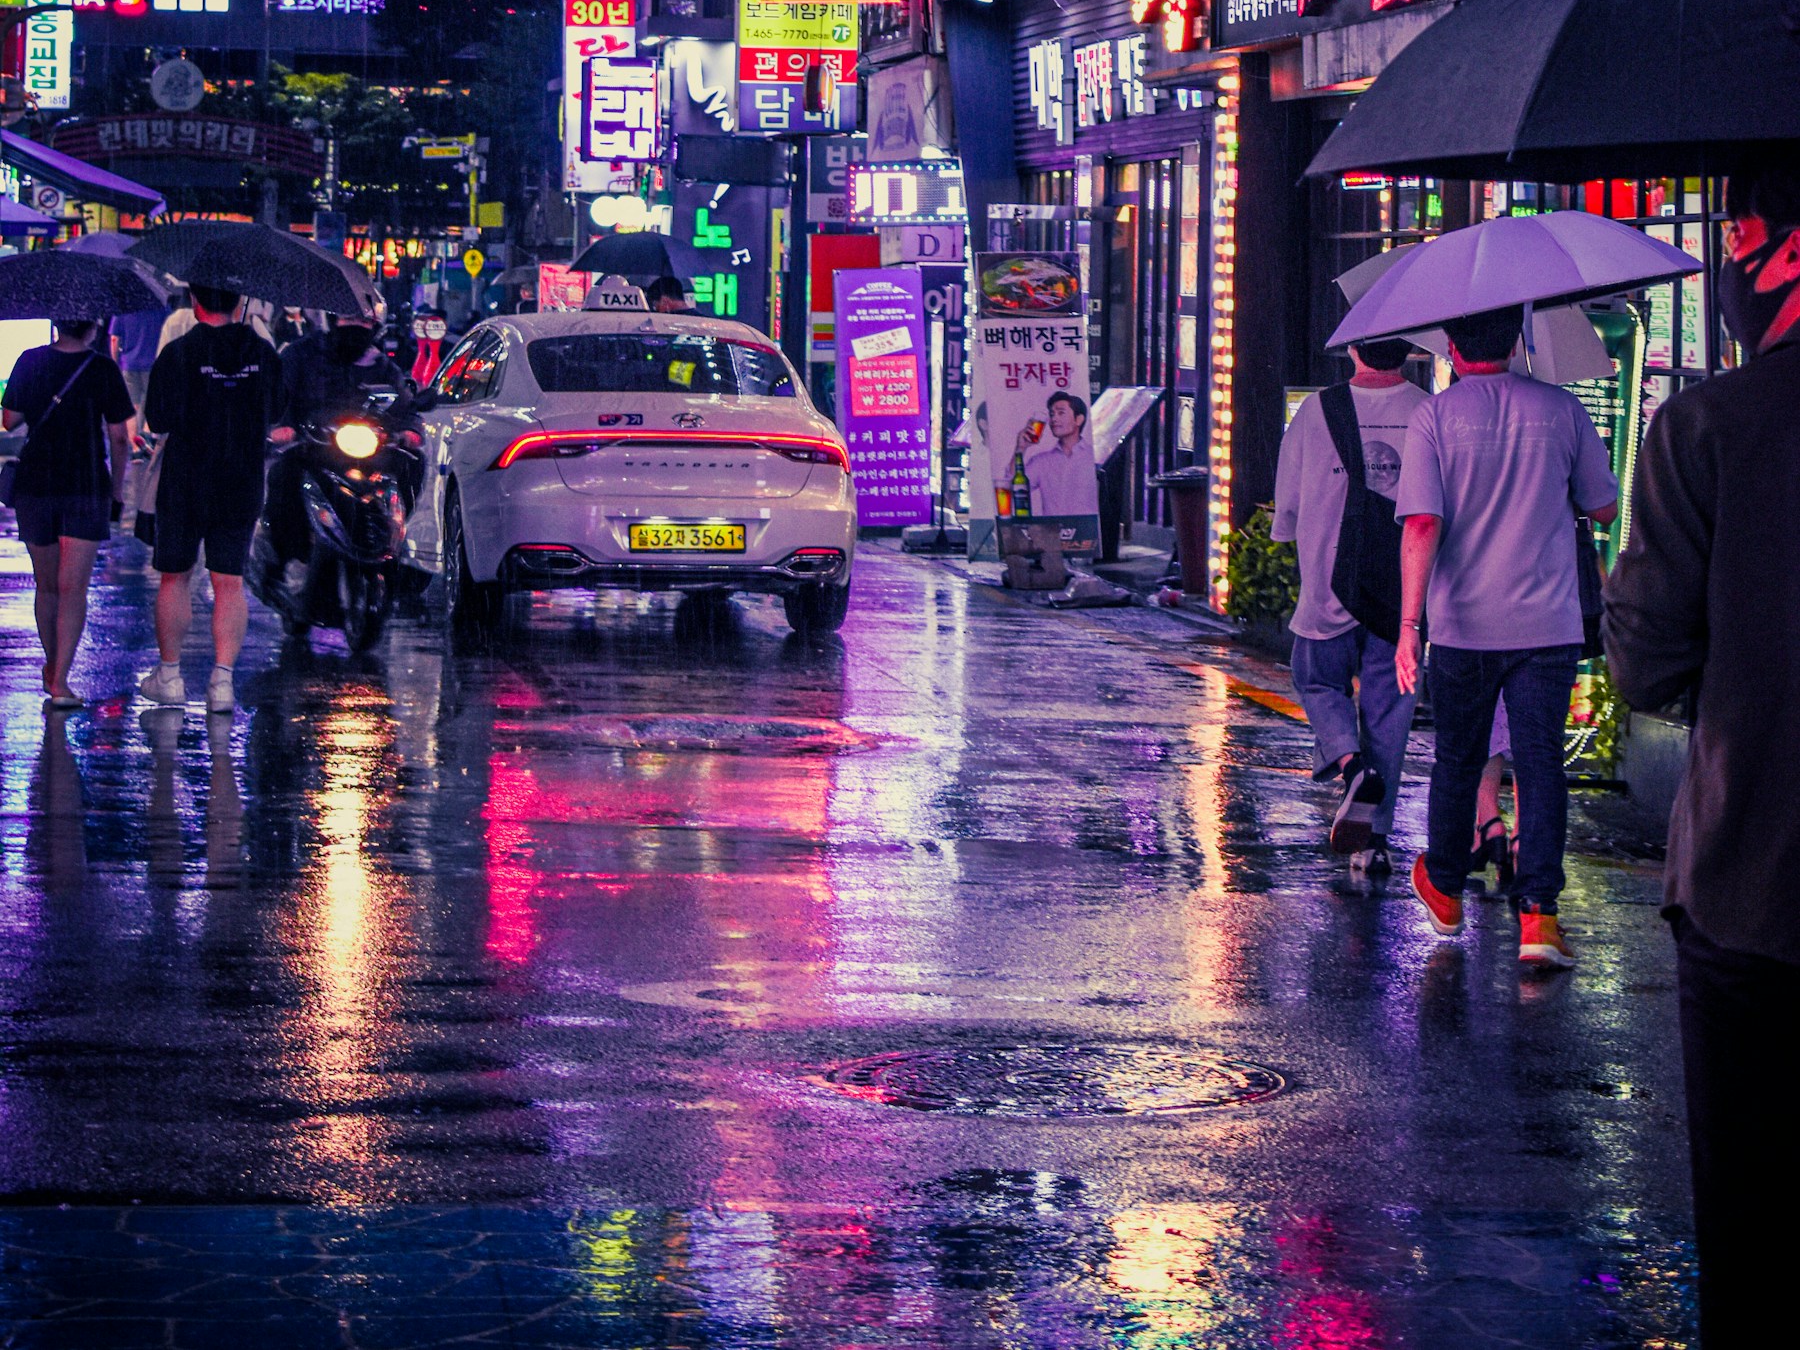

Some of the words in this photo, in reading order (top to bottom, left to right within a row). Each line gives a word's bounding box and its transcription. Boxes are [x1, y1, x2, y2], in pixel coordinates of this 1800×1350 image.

[571, 0, 630, 26] 30년
[745, 28, 809, 40] T.465-7770
[833, 26, 851, 41] 7F
[754, 52, 843, 81] 편의점
[602, 293, 640, 307] TAXI
[984, 326, 1083, 352] 뼈해장국
[999, 361, 1073, 389] 감자탕
[879, 394, 910, 406] 2800
[690, 528, 736, 547] 3561
